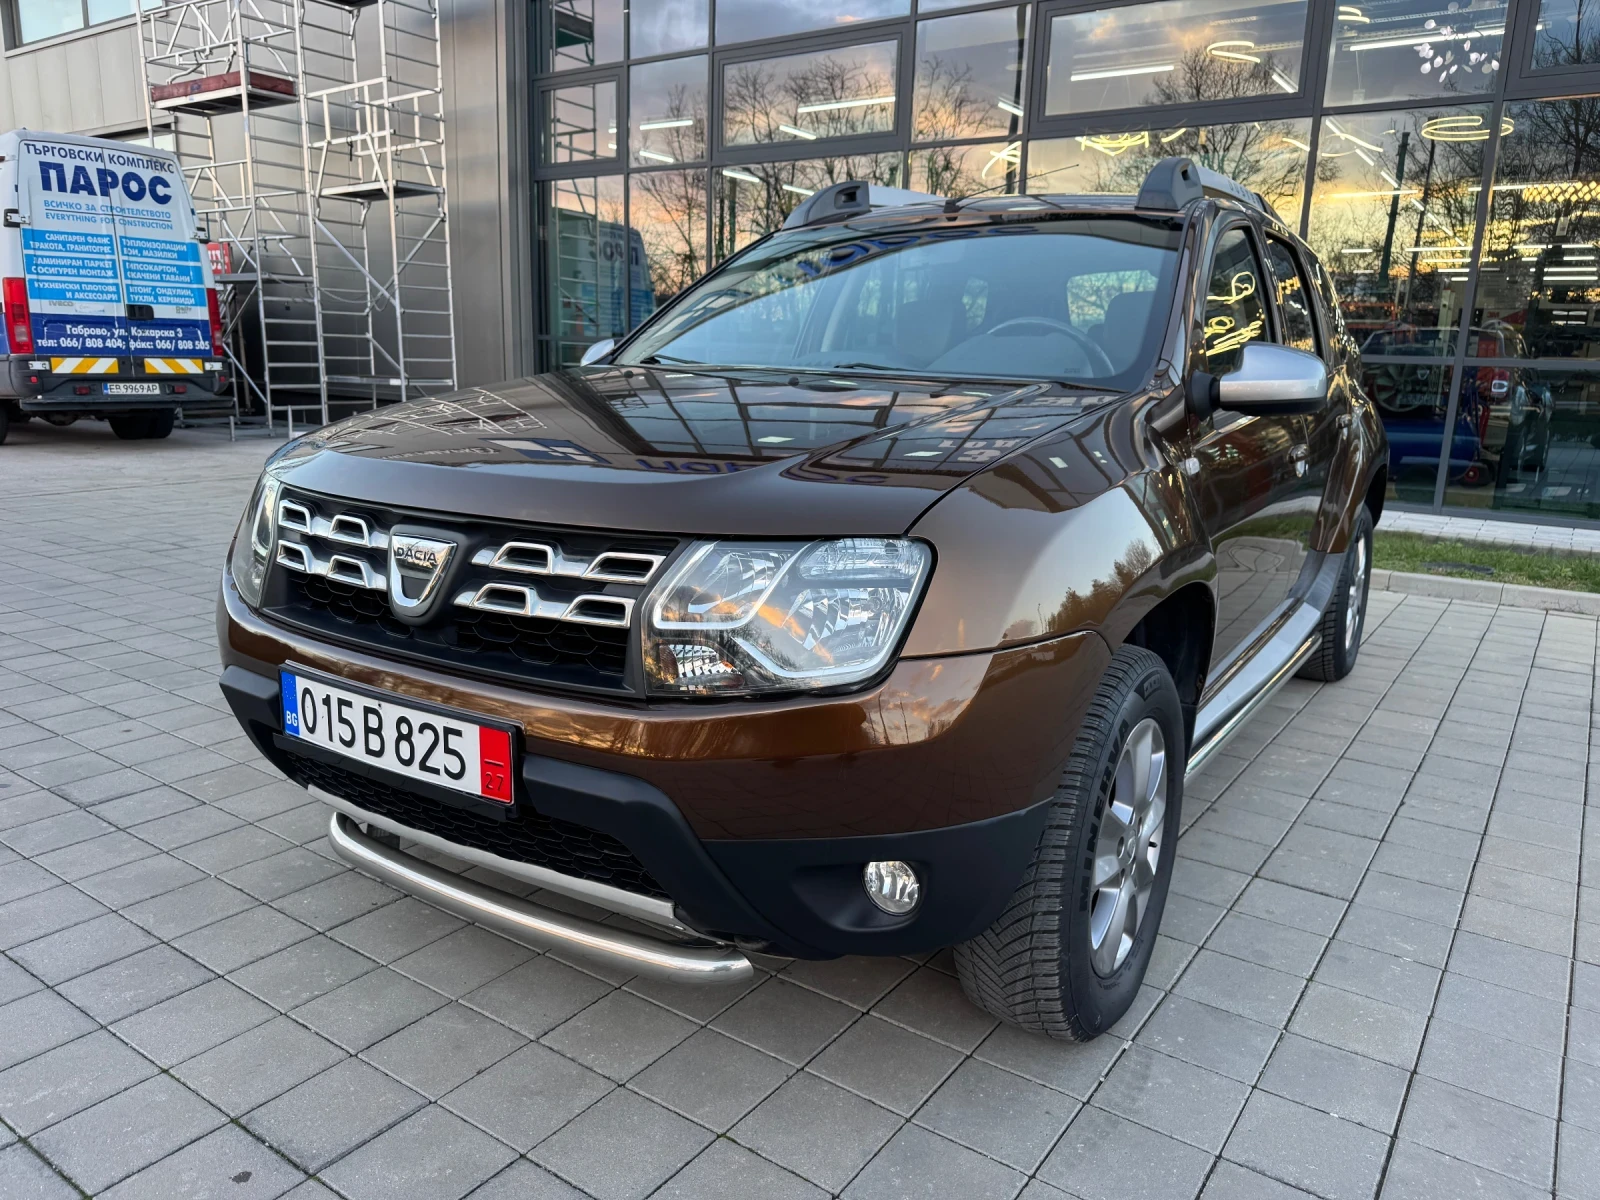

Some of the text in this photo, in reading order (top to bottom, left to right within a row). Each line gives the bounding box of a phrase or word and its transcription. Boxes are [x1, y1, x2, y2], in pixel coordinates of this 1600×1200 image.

[24, 143, 175, 174] ТЪРГОВСКИ КОМПЛЕКС
[38, 160, 172, 205] ПАРОС
[44, 200, 172, 219] ВСИЧКО ЗА СТРОИТЕЛСТВОТО
[45, 212, 173, 230] EVERYTHING FOR CONSTRUCTION
[46, 233, 85, 241] САНИТАРЕН
[30, 241, 111, 253] ТРАКОТА, ГРАНИТОГРЕС
[142, 249, 178, 259] МАЗИЛКИ
[84, 260, 112, 268] ПАРКЕТ
[38, 266, 78, 275] ОСИГУРЕН
[80, 269, 114, 277] МОНТАЖ
[162, 274, 191, 282] ТАВАНИ
[74, 292, 118, 300] АКСЕСОАРИ
[158, 295, 195, 305] КЕРЕМИДИ
[66, 324, 110, 337] Габрово,
[112, 328, 128, 338] ул.
[176, 328, 183, 338] 3
[36, 338, 210, 351] тел: 066/ 808 404; факс: 066/ 808 505
[396, 546, 438, 564] DACIA
[286, 710, 298, 727] BG
[486, 771, 505, 792] 27
[1079, 718, 1129, 912] MINERVA
